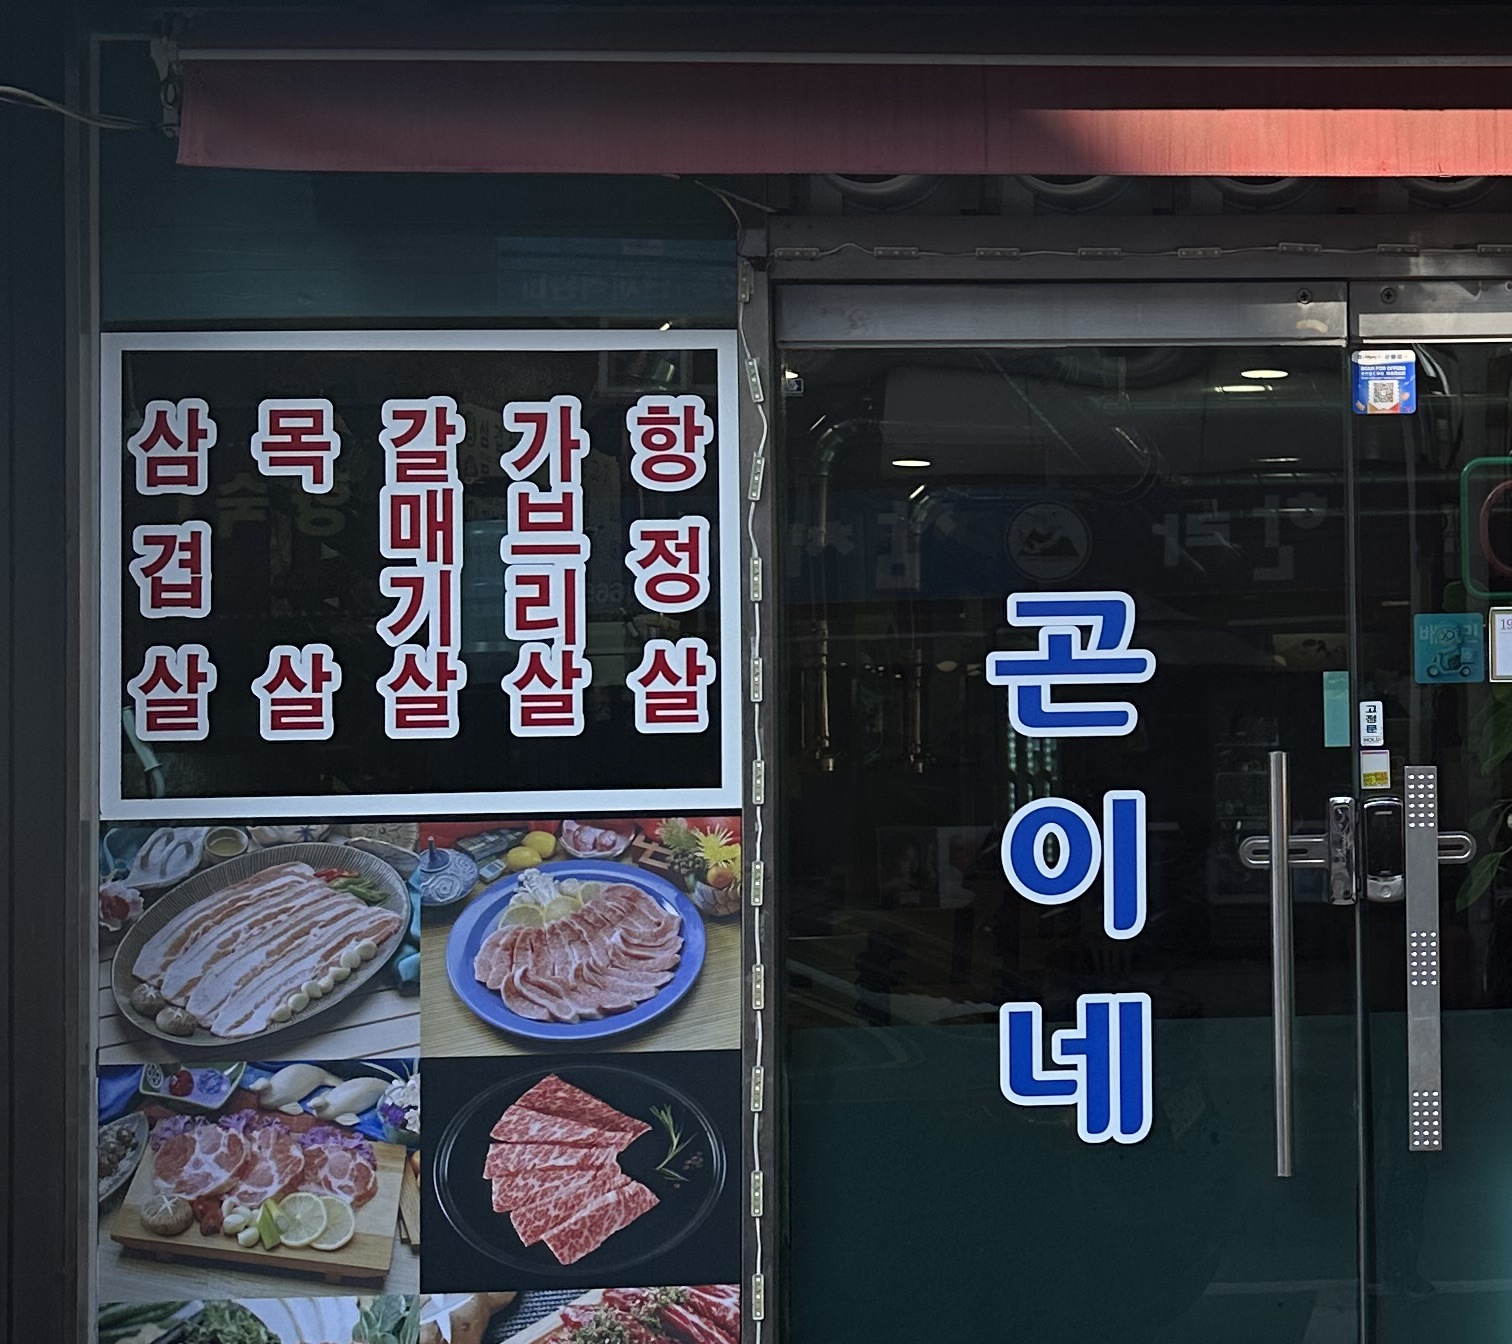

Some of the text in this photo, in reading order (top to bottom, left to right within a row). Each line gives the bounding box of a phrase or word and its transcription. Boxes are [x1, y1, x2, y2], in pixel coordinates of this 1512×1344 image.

[127, 398, 217, 741] 삼겹살
[251, 398, 341, 741] 목살
[377, 396, 466, 739] 갈매기살
[500, 396, 591, 737] 가브리살
[625, 395, 716, 733] 항정살
[986, 591, 1157, 1145] 곤이네
